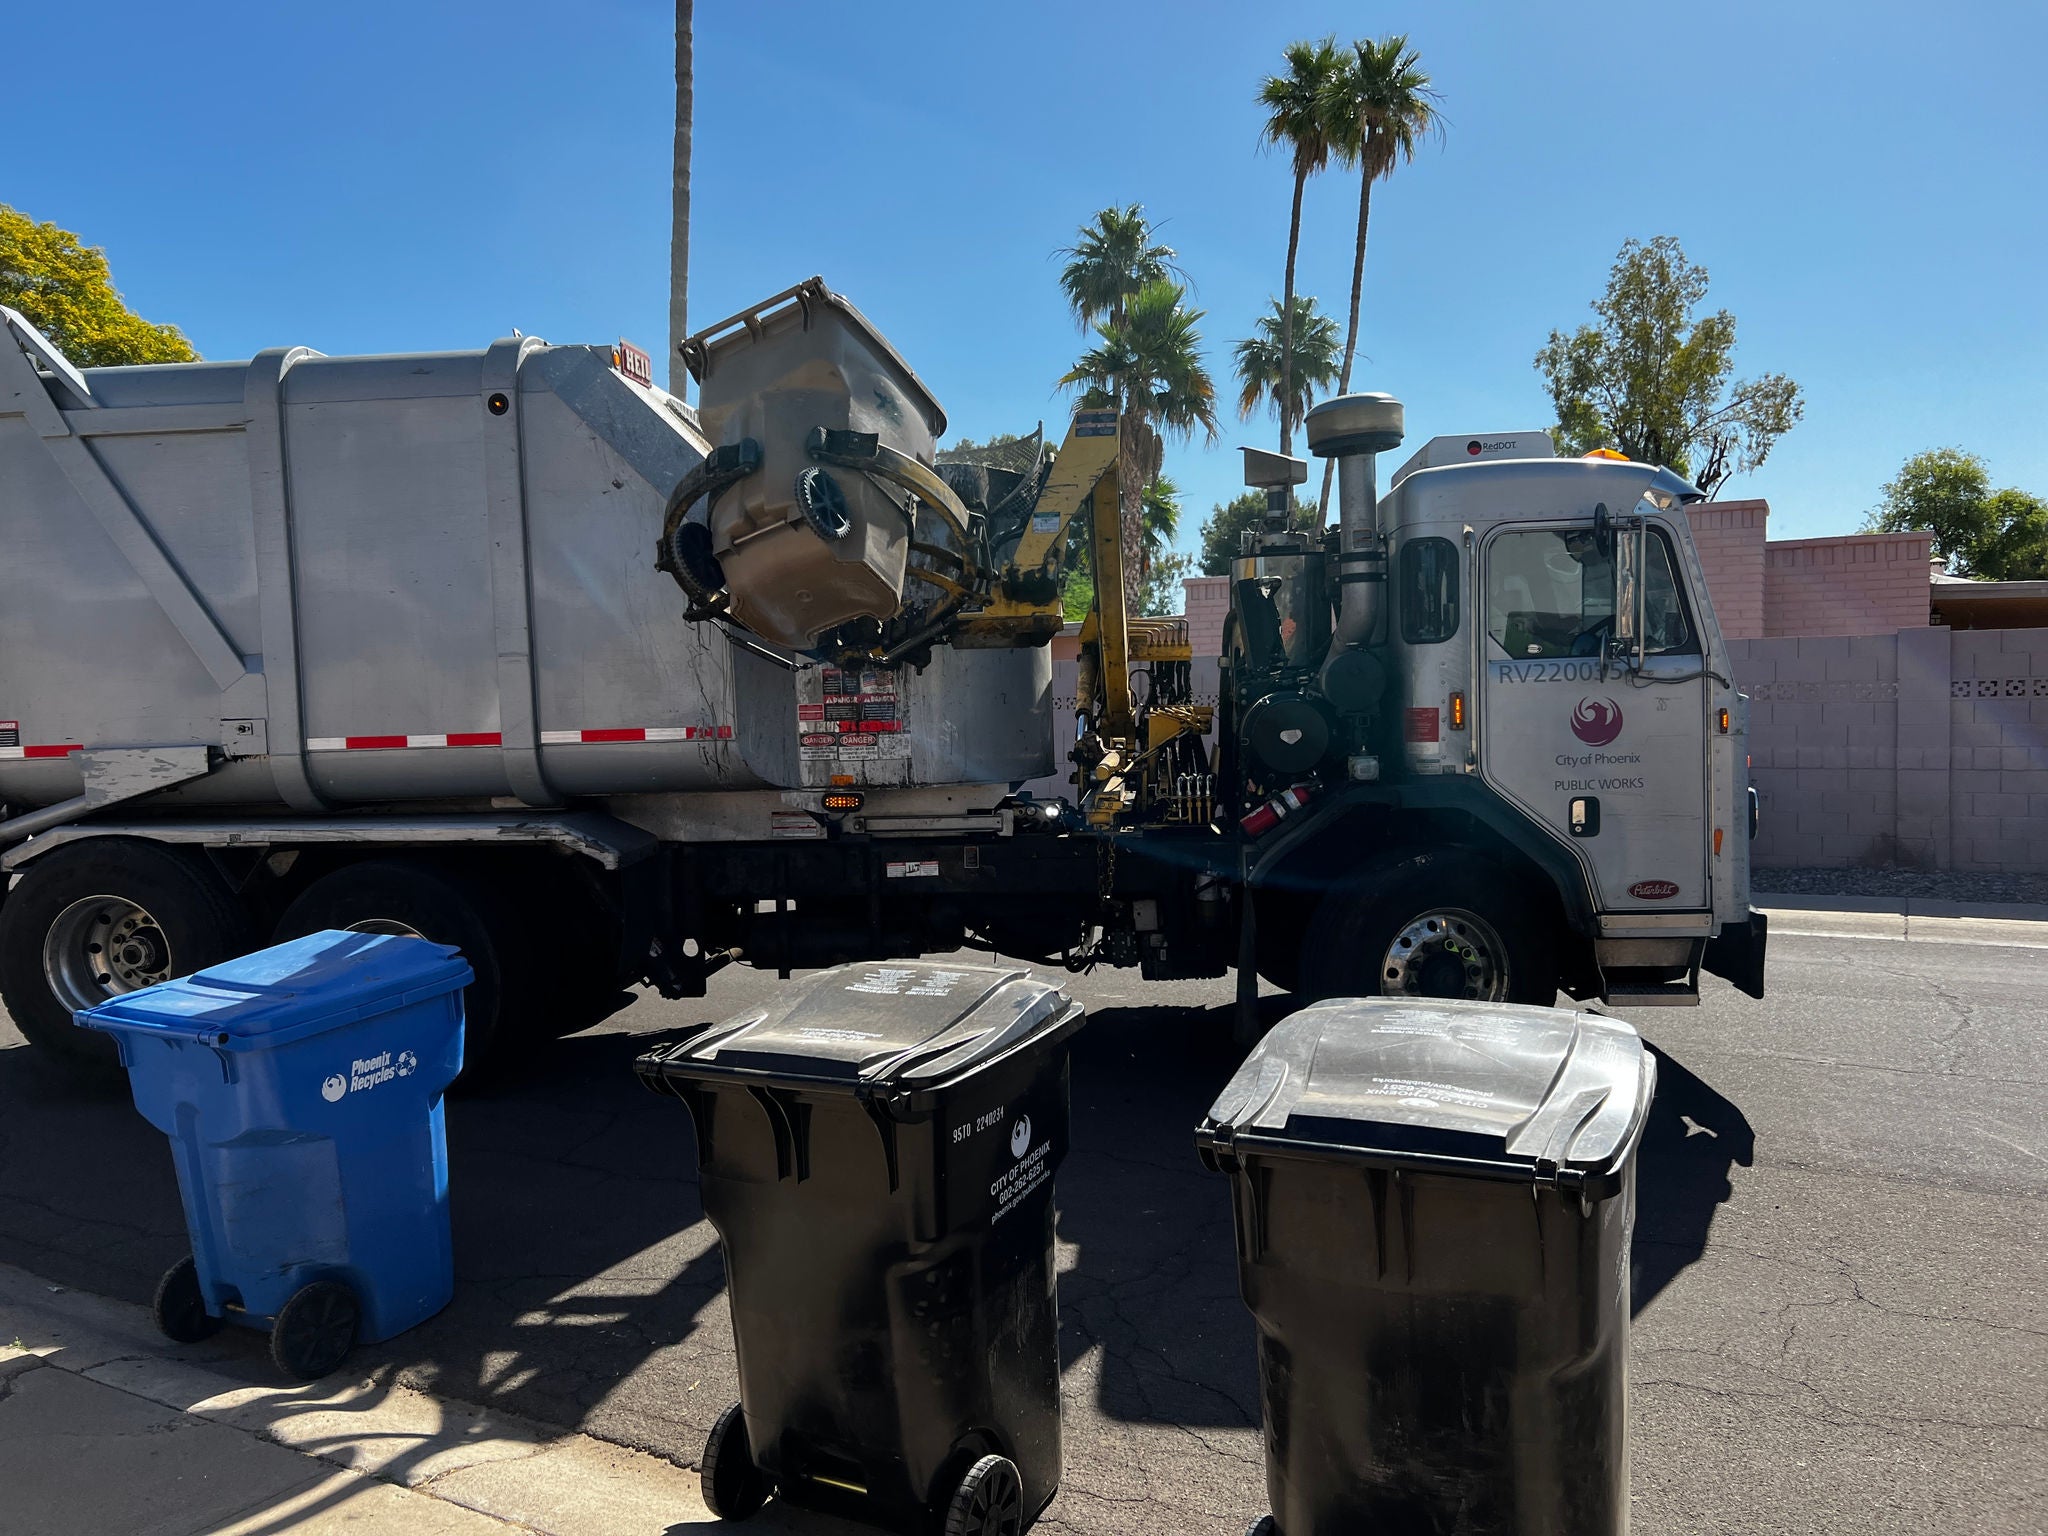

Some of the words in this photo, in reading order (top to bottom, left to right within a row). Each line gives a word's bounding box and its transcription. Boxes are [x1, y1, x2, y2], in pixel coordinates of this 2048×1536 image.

[626, 349, 650, 381] HEIL
[1483, 441, 1516, 450] RedDOT
[842, 736, 873, 744] DANGER
[1555, 754, 1579, 768] City
[1580, 753, 1593, 766] of
[1594, 752, 1641, 765] Phoenix
[1554, 780, 1596, 791] PUBLIC
[1599, 778, 1644, 790] WORKS
[1634, 884, 1676, 895] Peterbilt
[351, 1051, 391, 1077] Phoenix
[350, 1066, 395, 1092] Recycles
[1365, 1088, 1428, 1098] PHOENIX
[1429, 1095, 1452, 1103] OF
[1454, 1099, 1488, 1109] CITY
[976, 1105, 1004, 1132] 2240234
[990, 1174, 1008, 1196] CITY
[1008, 1164, 1019, 1182] OF
[1020, 1140, 1051, 1173] PHOENIX
[999, 1160, 1044, 1205] 602-262-6251
